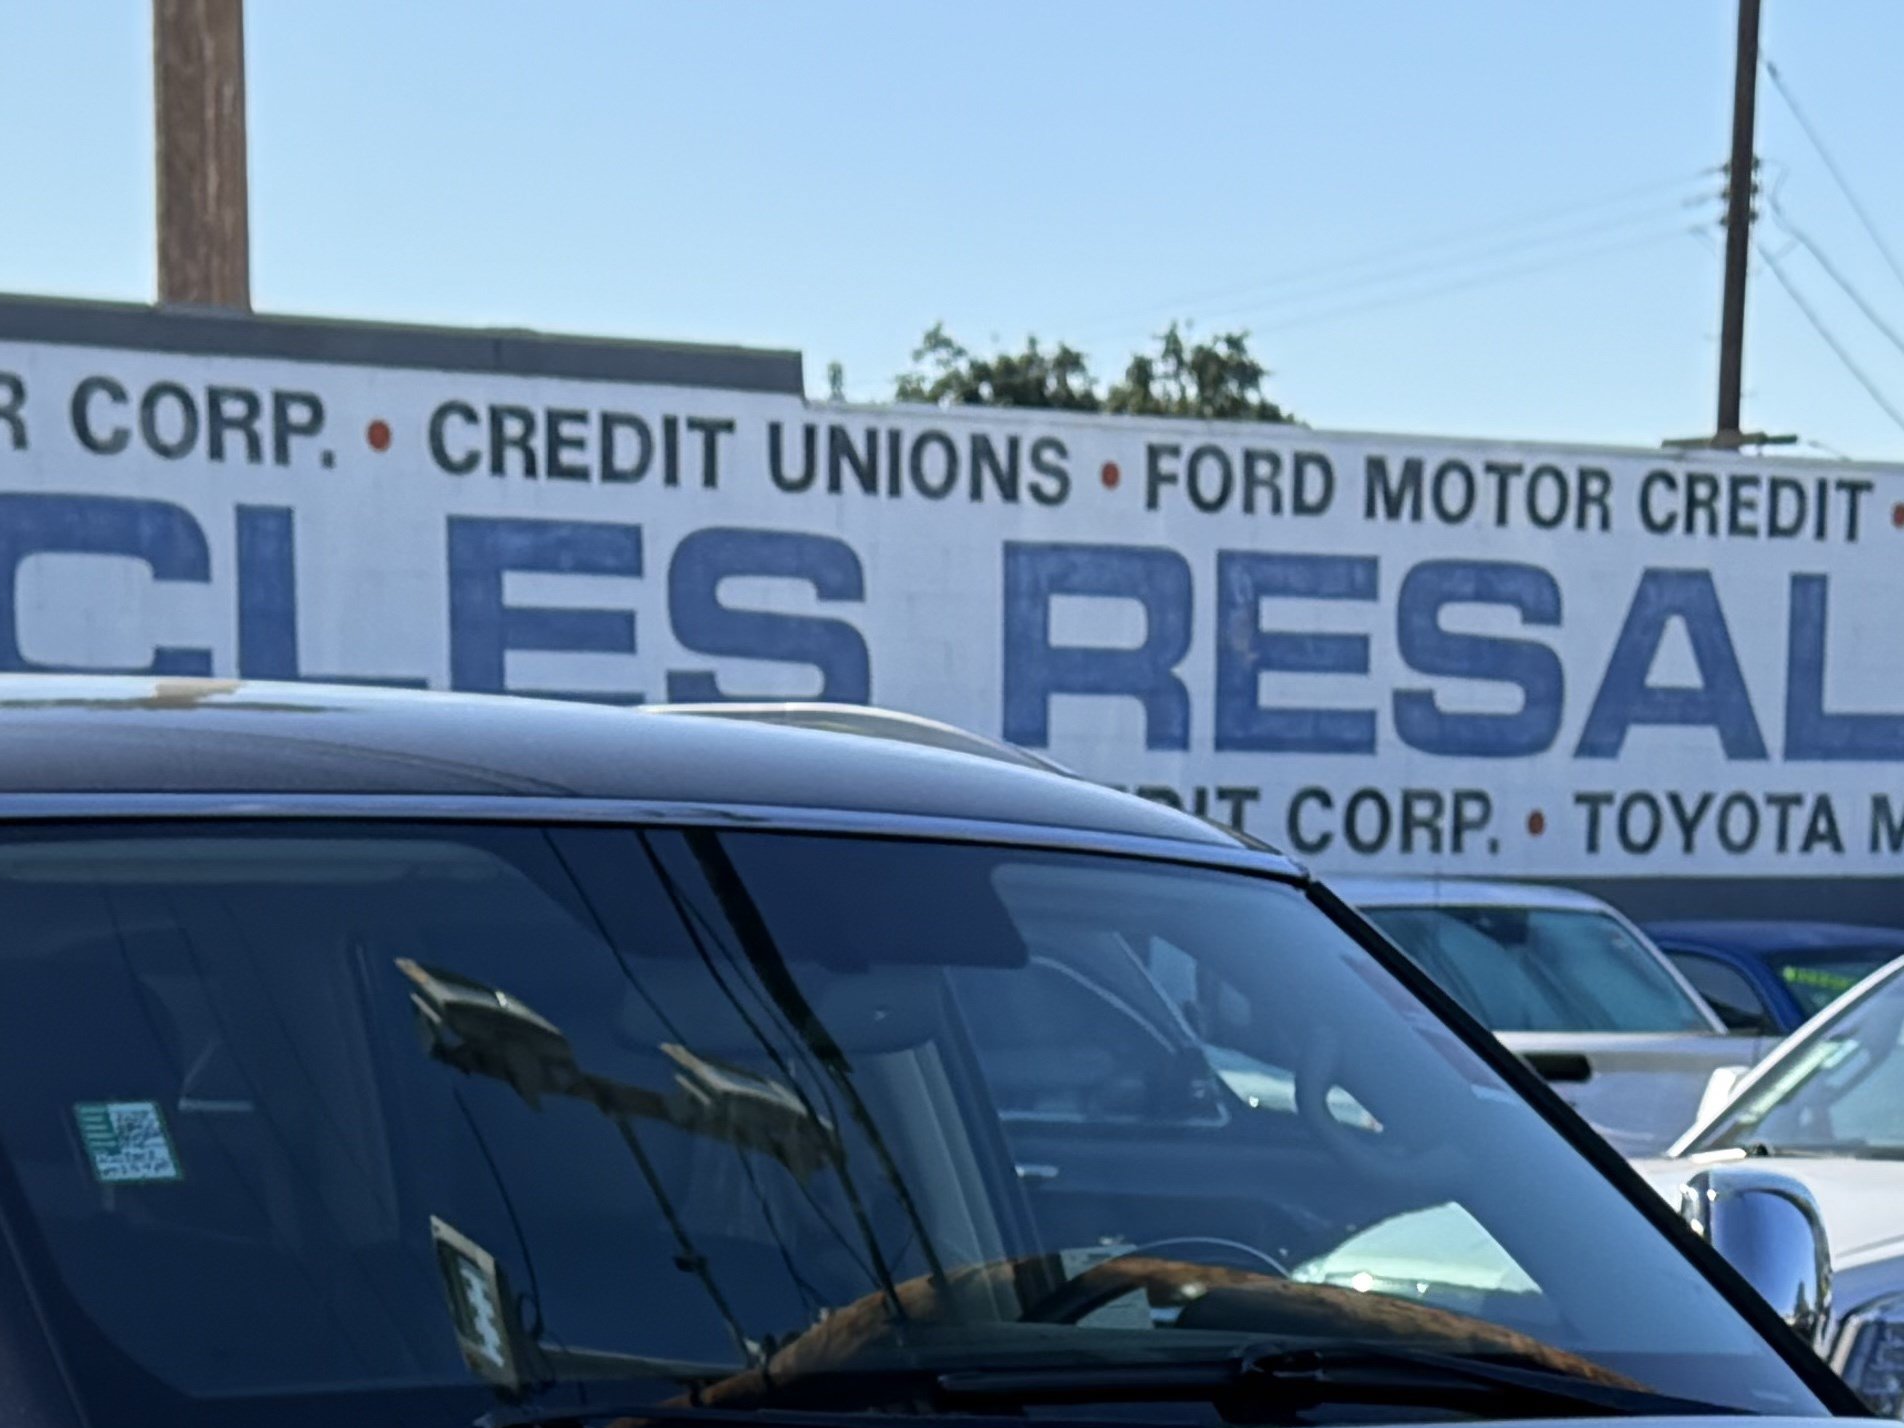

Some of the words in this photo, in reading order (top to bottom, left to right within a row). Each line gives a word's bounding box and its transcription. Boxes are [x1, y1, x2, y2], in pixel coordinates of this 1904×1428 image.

[70, 374, 337, 470] CORP.
[427, 400, 735, 488] CREDIT
[768, 420, 1071, 509] UNIONS
[1143, 442, 1336, 517] FORD
[1363, 457, 1613, 533] MOTOR
[1638, 470, 1875, 543] CREDIT
[1286, 785, 1501, 856] CORP.
[1574, 791, 1844, 854] TOYOTA
